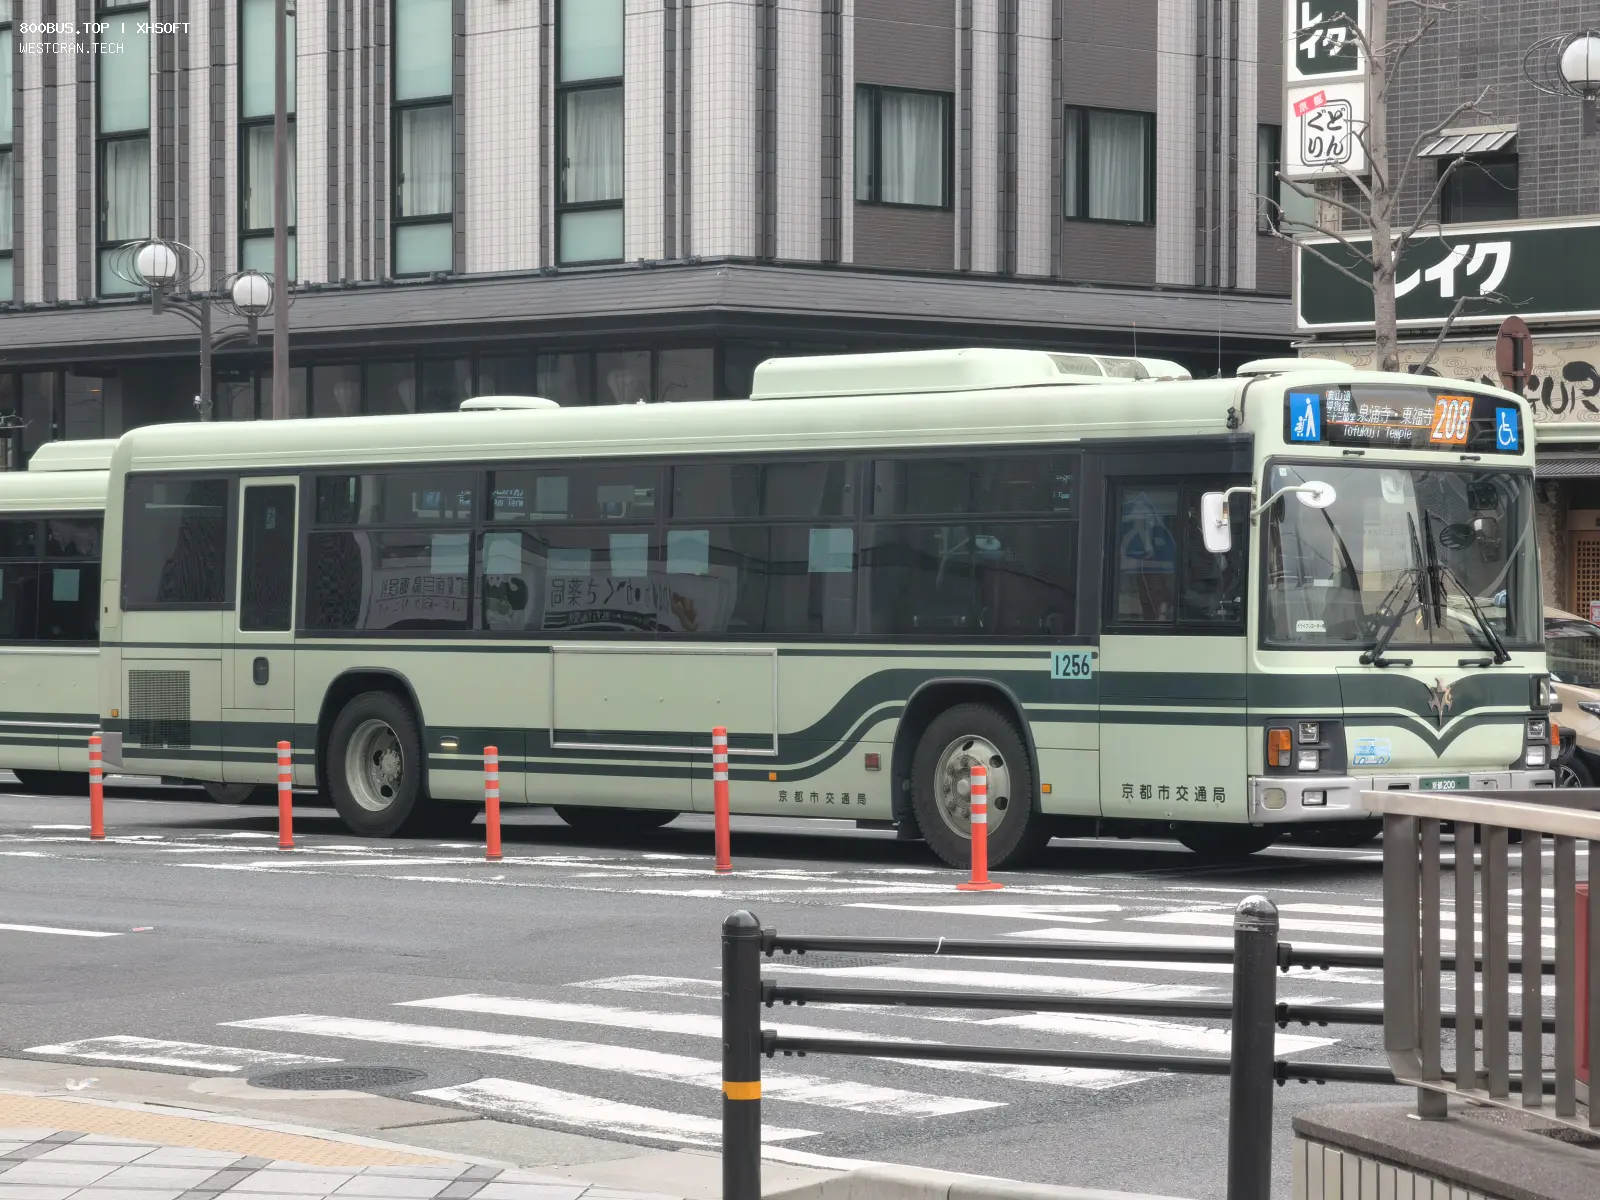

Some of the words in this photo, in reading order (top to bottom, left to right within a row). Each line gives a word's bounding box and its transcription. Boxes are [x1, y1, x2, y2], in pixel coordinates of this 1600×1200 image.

[1300, 2, 1346, 58] レイク
[1432, 399, 1470, 440] 208
[1343, 424, 1381, 439] Tofukuji
[1386, 426, 1413, 440] Temple
[1055, 654, 1090, 677] 1256
[779, 790, 867, 805] 京都市交通局
[1122, 783, 1226, 803] 京都市交通局
